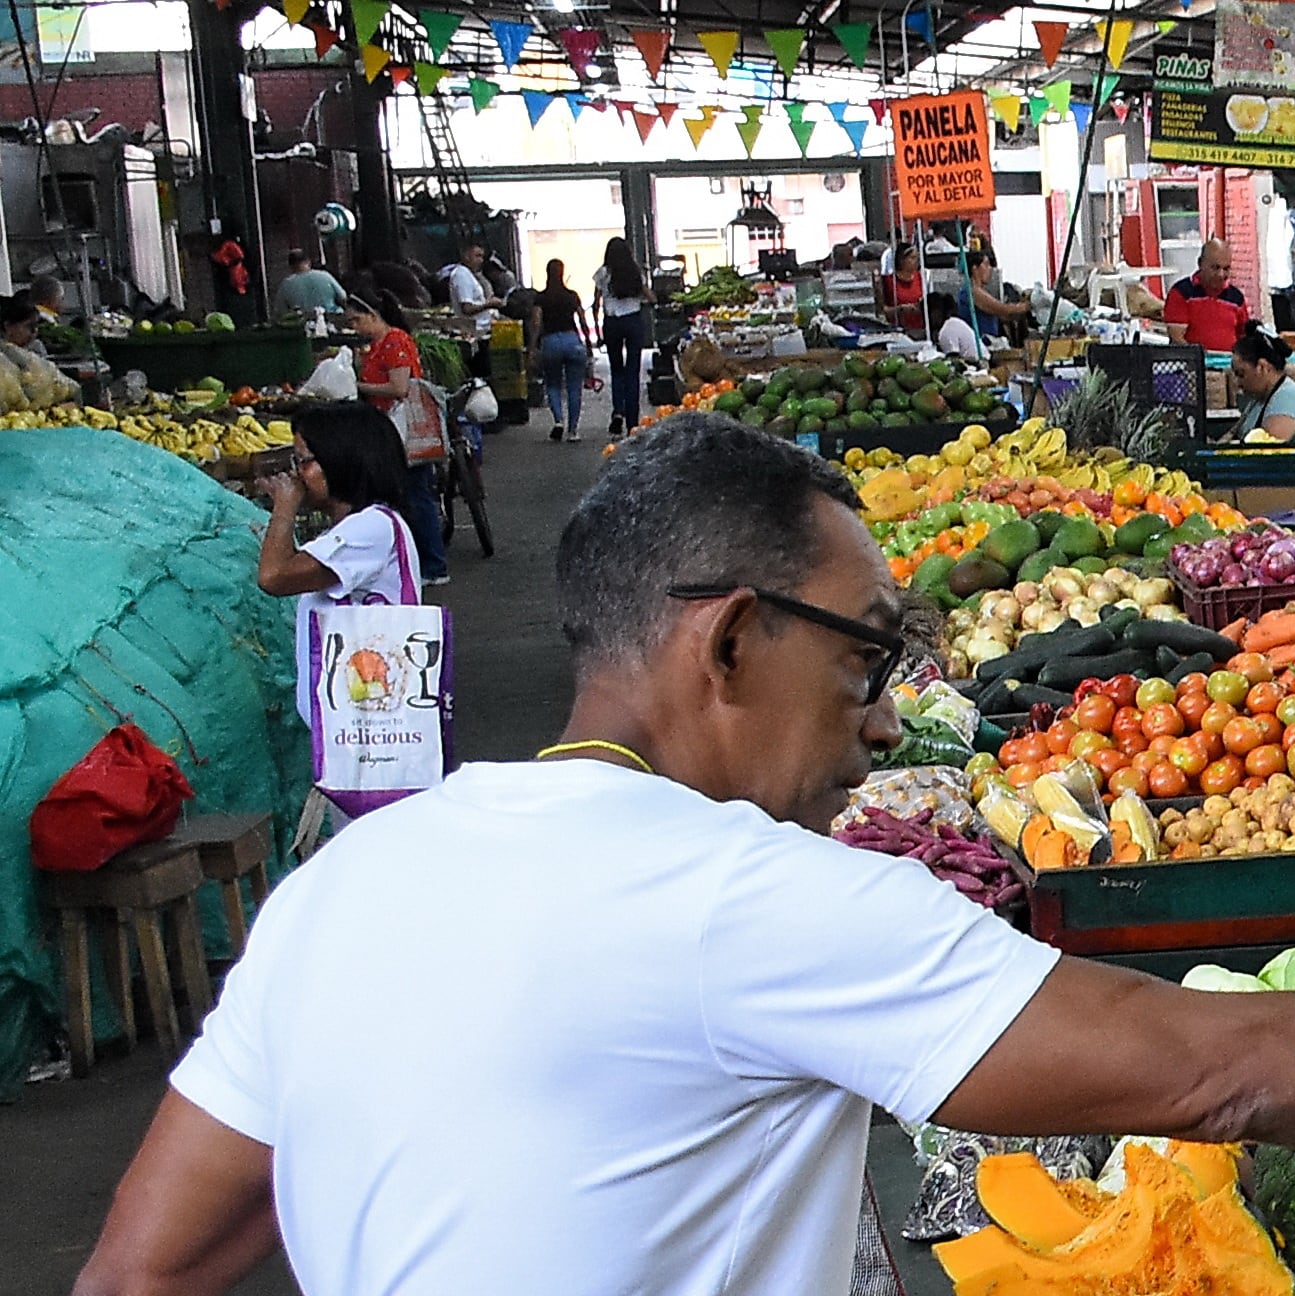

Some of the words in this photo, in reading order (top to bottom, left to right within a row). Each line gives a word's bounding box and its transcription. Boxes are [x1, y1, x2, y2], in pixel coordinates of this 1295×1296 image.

[1155, 53, 1211, 80] PIÑAS
[899, 103, 978, 141] PANELA
[903, 138, 981, 169] CAUCANA
[907, 174, 935, 189] POR
[938, 168, 983, 187] MAYOR
[912, 190, 921, 204] Y
[924, 189, 942, 204] AL
[943, 185, 984, 201] DETAL
[335, 727, 423, 746] delicious
